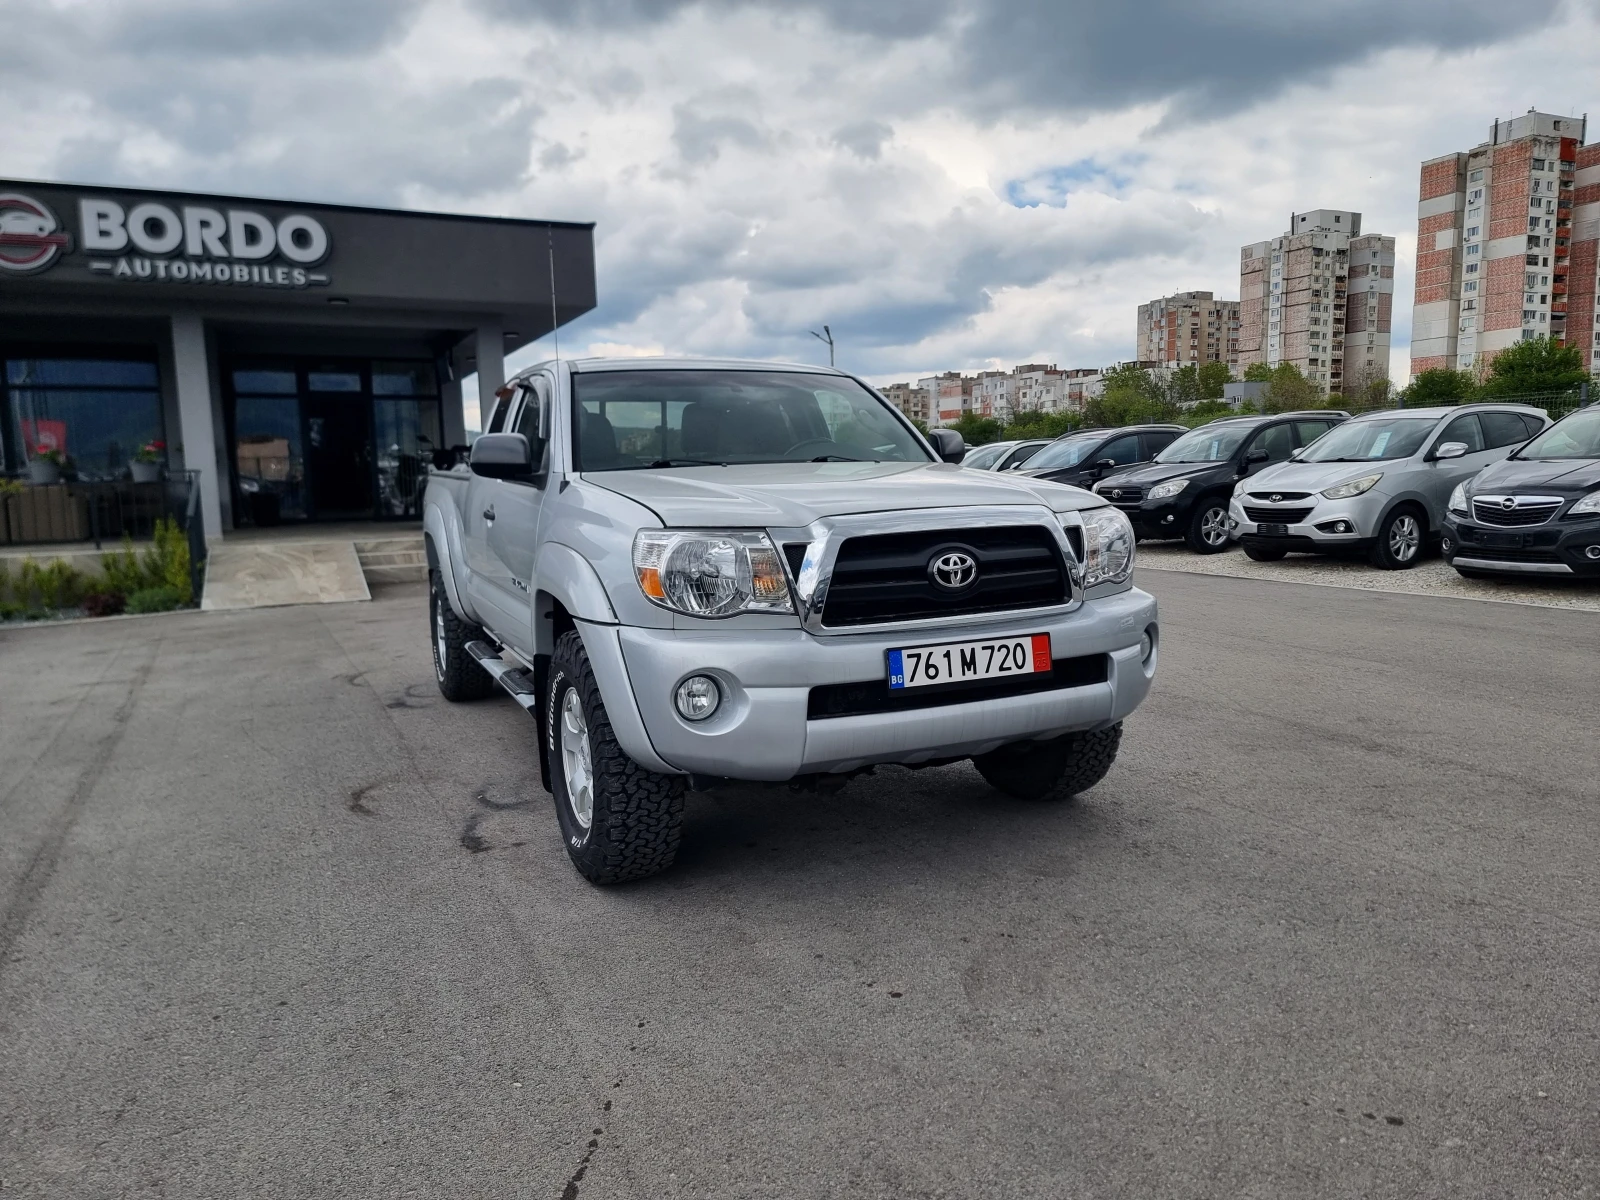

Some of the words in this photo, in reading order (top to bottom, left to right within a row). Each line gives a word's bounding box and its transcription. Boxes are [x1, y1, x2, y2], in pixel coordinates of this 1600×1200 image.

[80, 199, 328, 262] BORDO
[115, 258, 307, 286] AUTOMOBILES
[891, 675, 903, 684] BG
